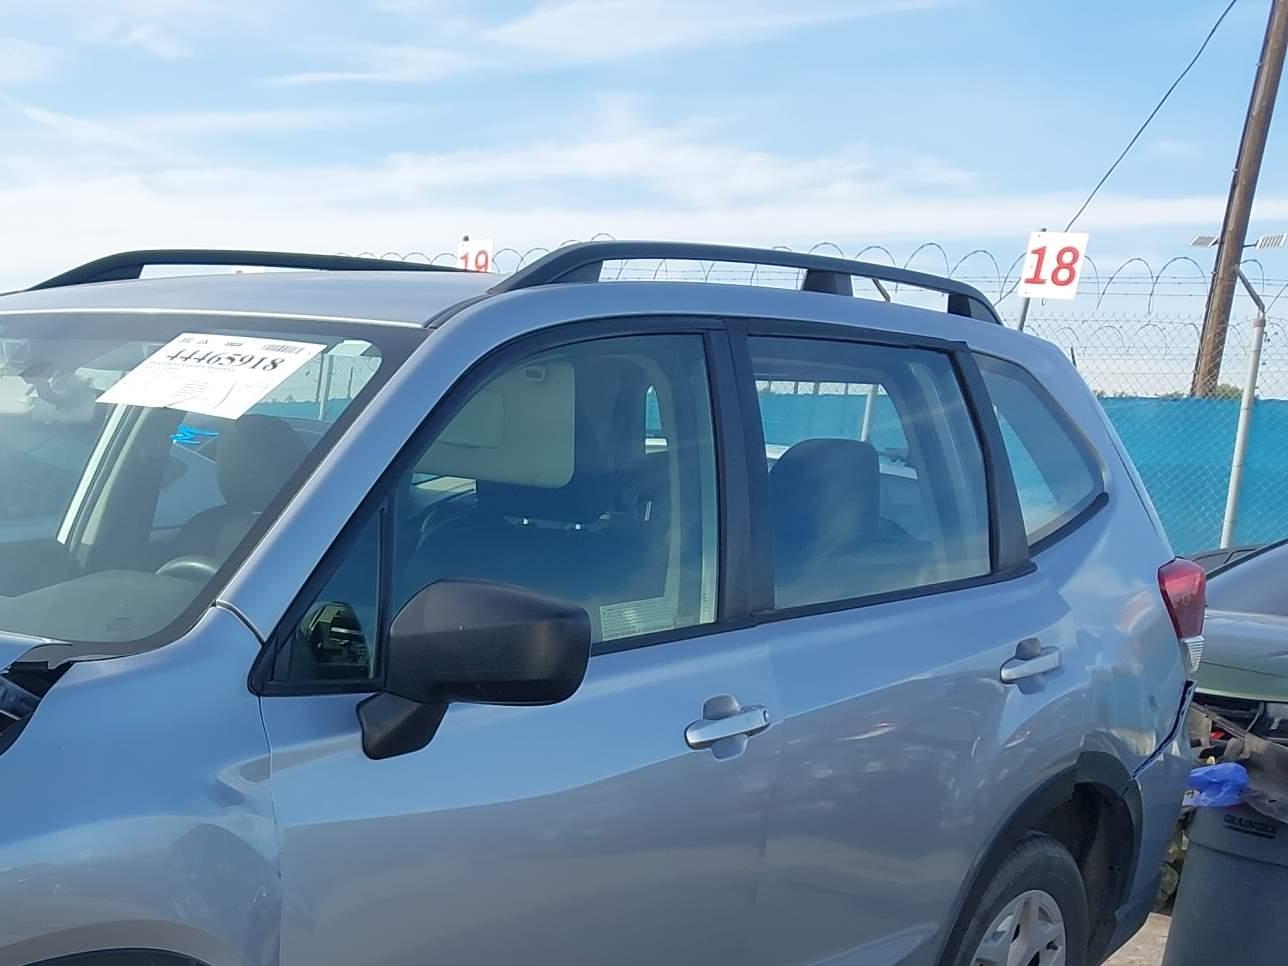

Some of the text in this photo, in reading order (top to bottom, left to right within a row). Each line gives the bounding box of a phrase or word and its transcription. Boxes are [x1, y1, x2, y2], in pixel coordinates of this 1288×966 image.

[460, 249, 489, 272] 19
[1024, 246, 1080, 287] 18
[167, 348, 285, 372] 44465918
